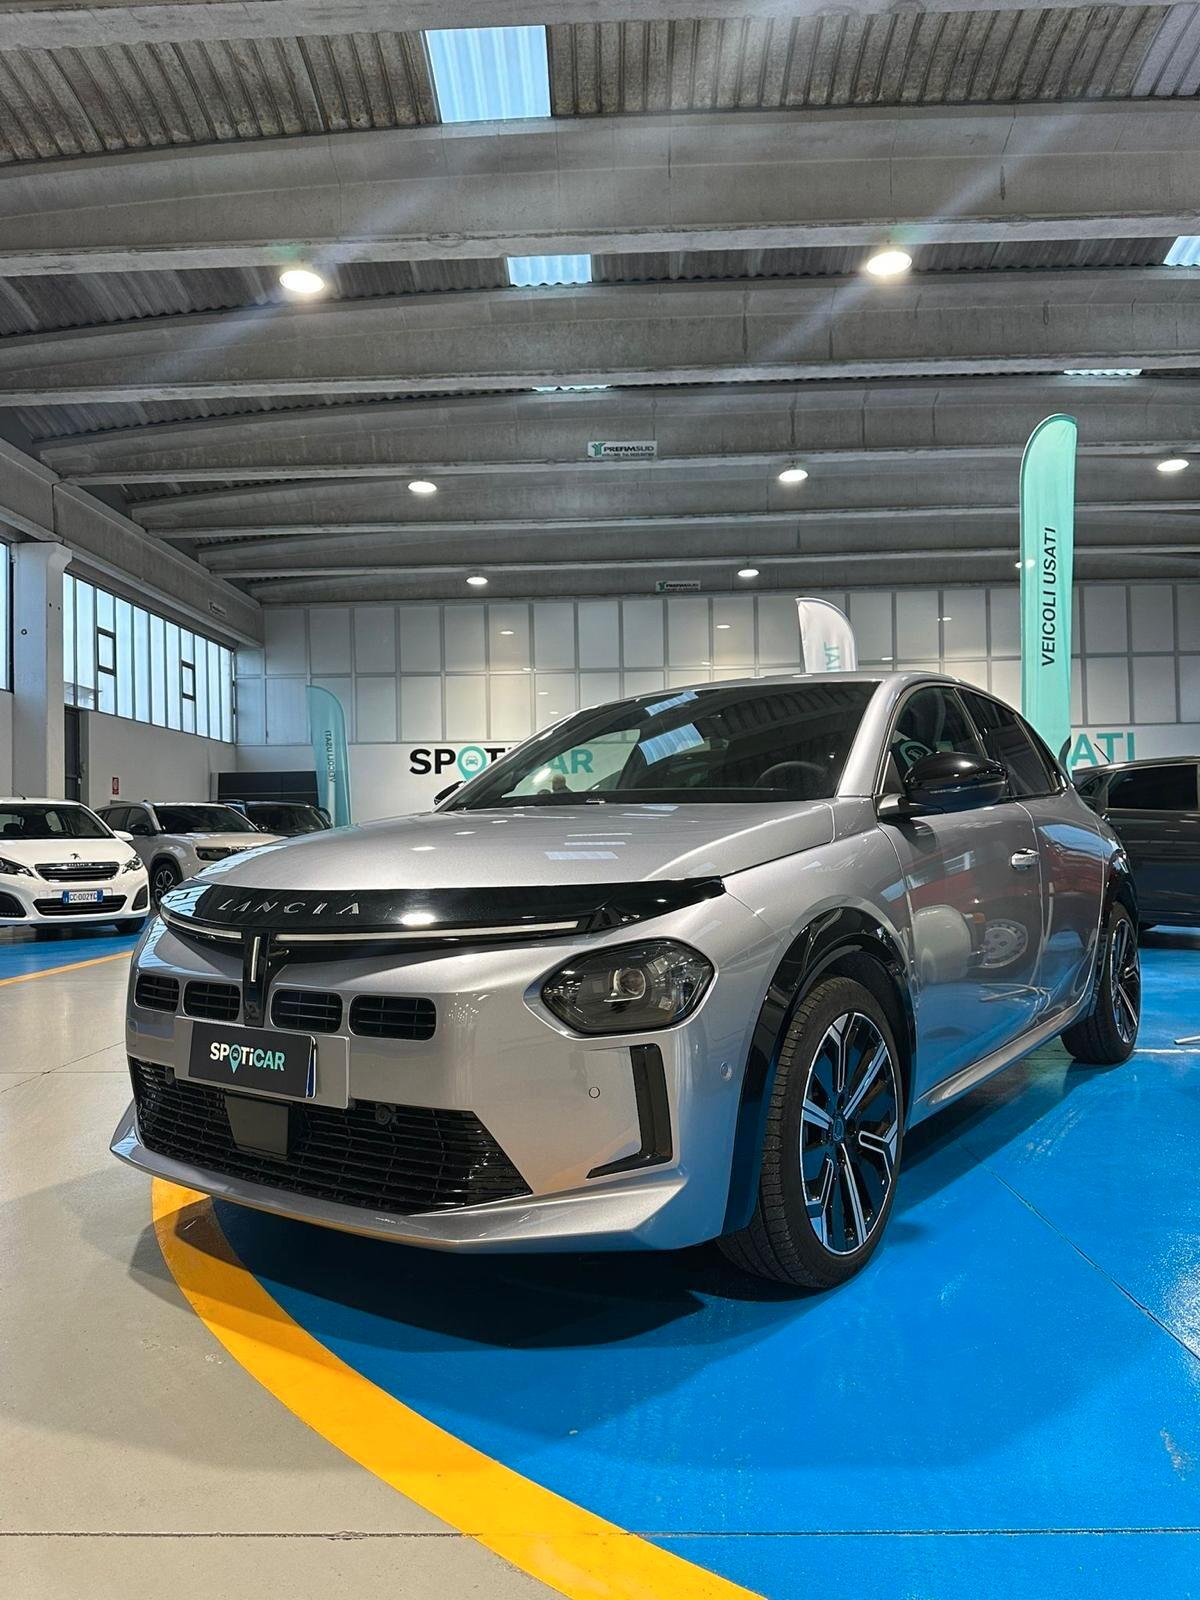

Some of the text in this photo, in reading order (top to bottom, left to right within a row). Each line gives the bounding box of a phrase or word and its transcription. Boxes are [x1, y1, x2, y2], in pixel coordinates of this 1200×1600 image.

[1041, 527, 1056, 666] VEICOLI USATI
[1071, 732, 1136, 766] ATI
[217, 898, 361, 915] LANCIA
